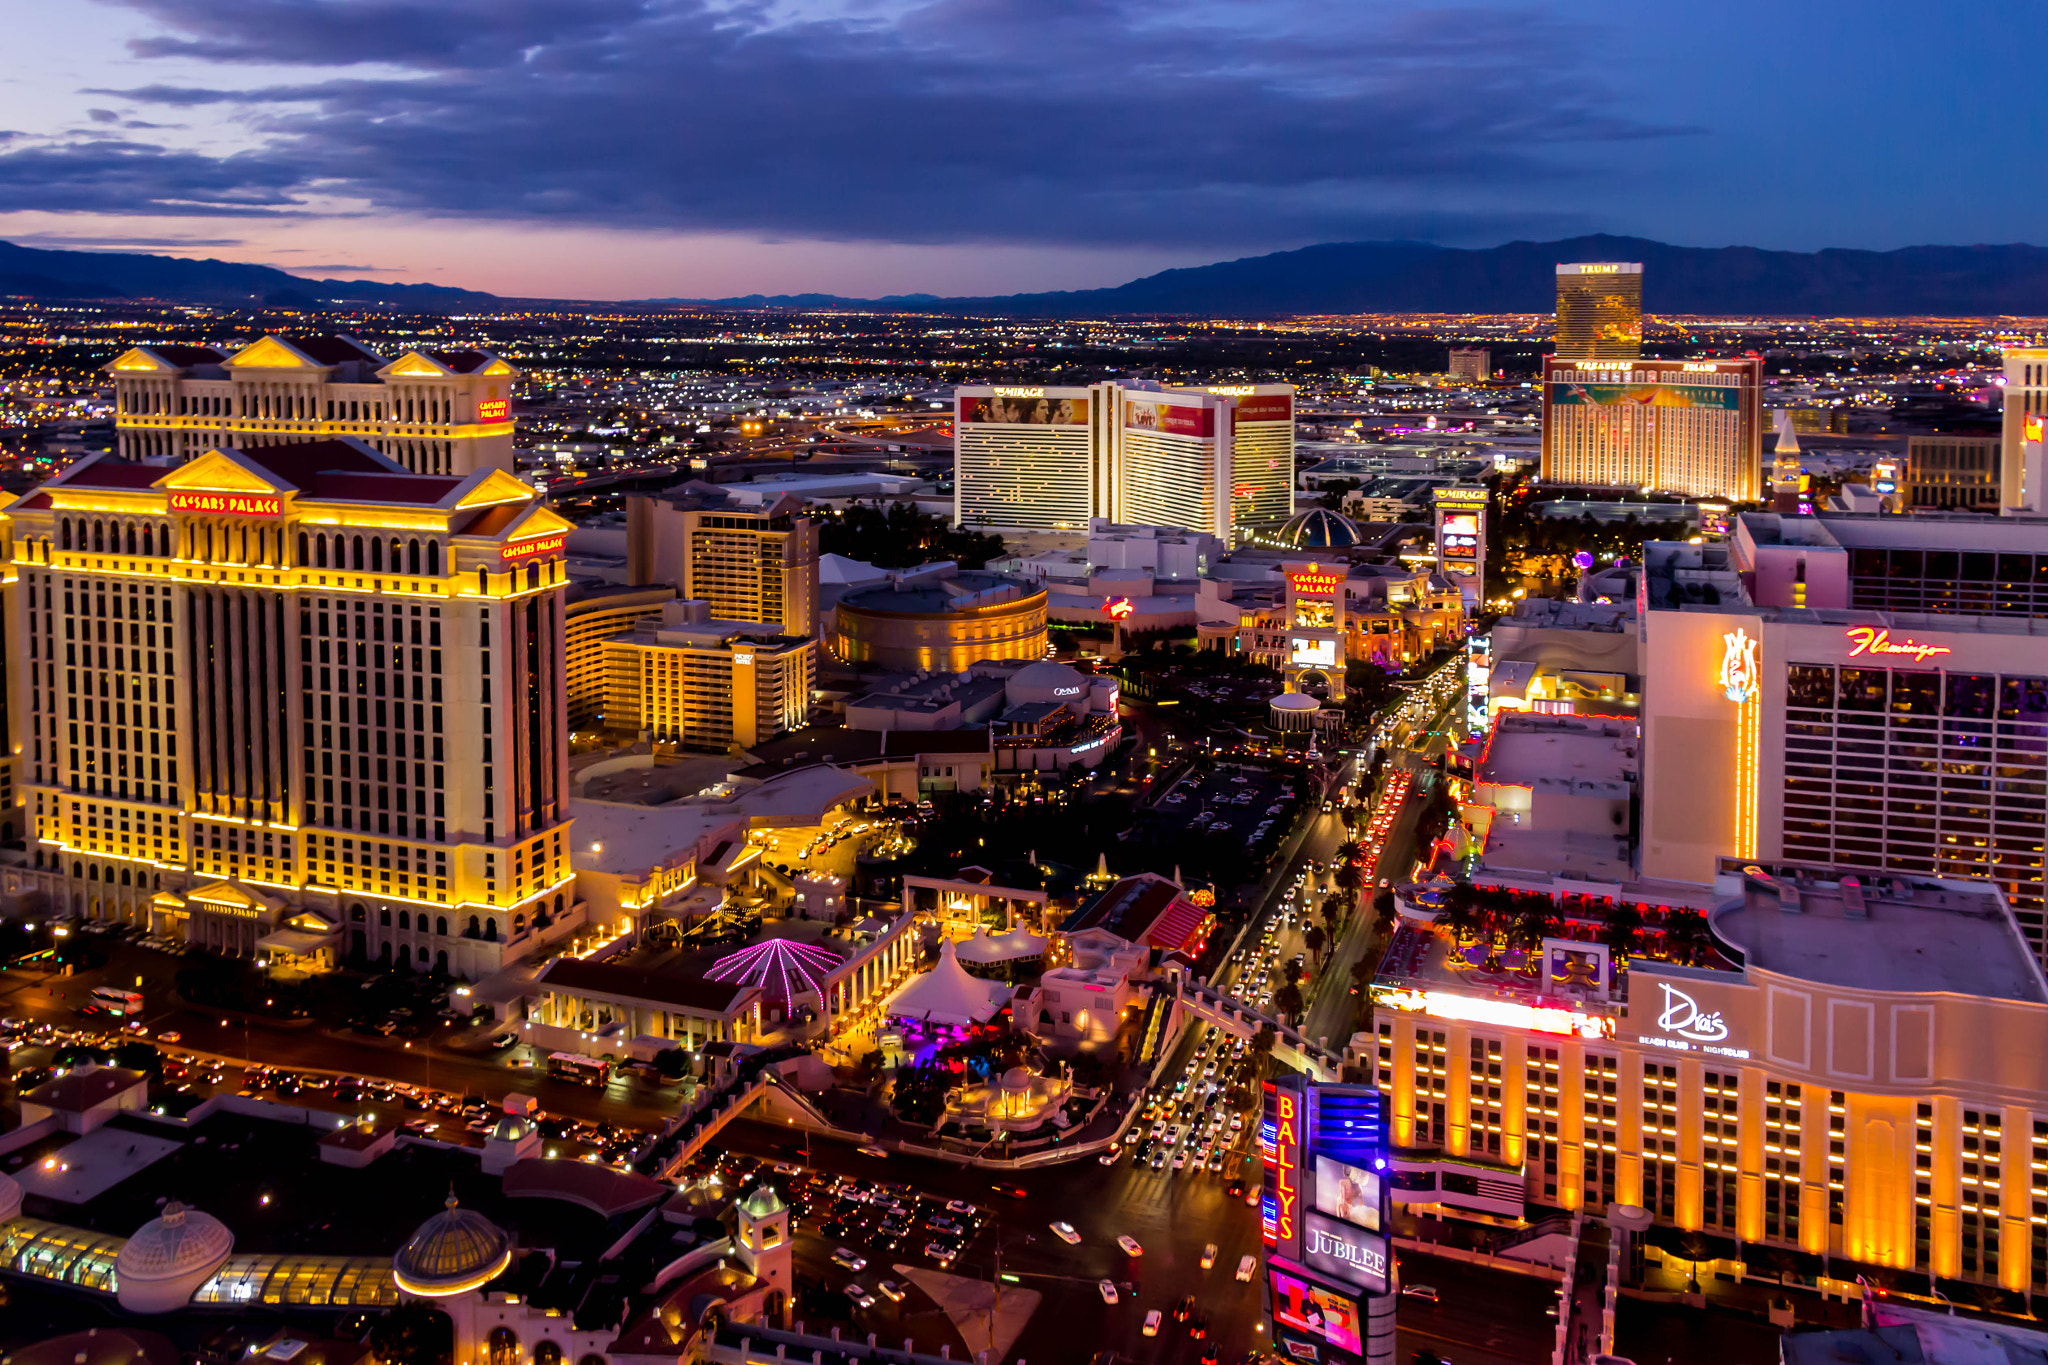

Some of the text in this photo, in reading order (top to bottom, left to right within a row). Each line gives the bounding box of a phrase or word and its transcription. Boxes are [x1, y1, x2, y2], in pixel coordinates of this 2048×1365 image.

[1580, 265, 1618, 273] TRUMP
[1575, 362, 1717, 372] TREASURE ISLAND
[997, 387, 1044, 398] MIRAGE
[1215, 386, 1255, 396] MIRAGE
[479, 400, 507, 410] CAESARS
[481, 409, 505, 418] PALACE
[1440, 490, 1487, 500] MIRAGE
[171, 494, 279, 513] CAESARS PALACE
[502, 537, 562, 559] CAESARS PALACE
[1292, 574, 1337, 584] CAESARS
[1295, 584, 1335, 594] PALACE
[1845, 627, 1951, 663] Flamingo
[1054, 686, 1080, 696] OMNIA
[203, 903, 231, 915] CAESARS
[233, 907, 258, 919] PALACE
[1639, 1036, 1751, 1059] BEACH CLUB NIGHTCLUB
[1277, 1094, 1296, 1240] BALLYS
[1305, 1228, 1385, 1274] JUBILEE
